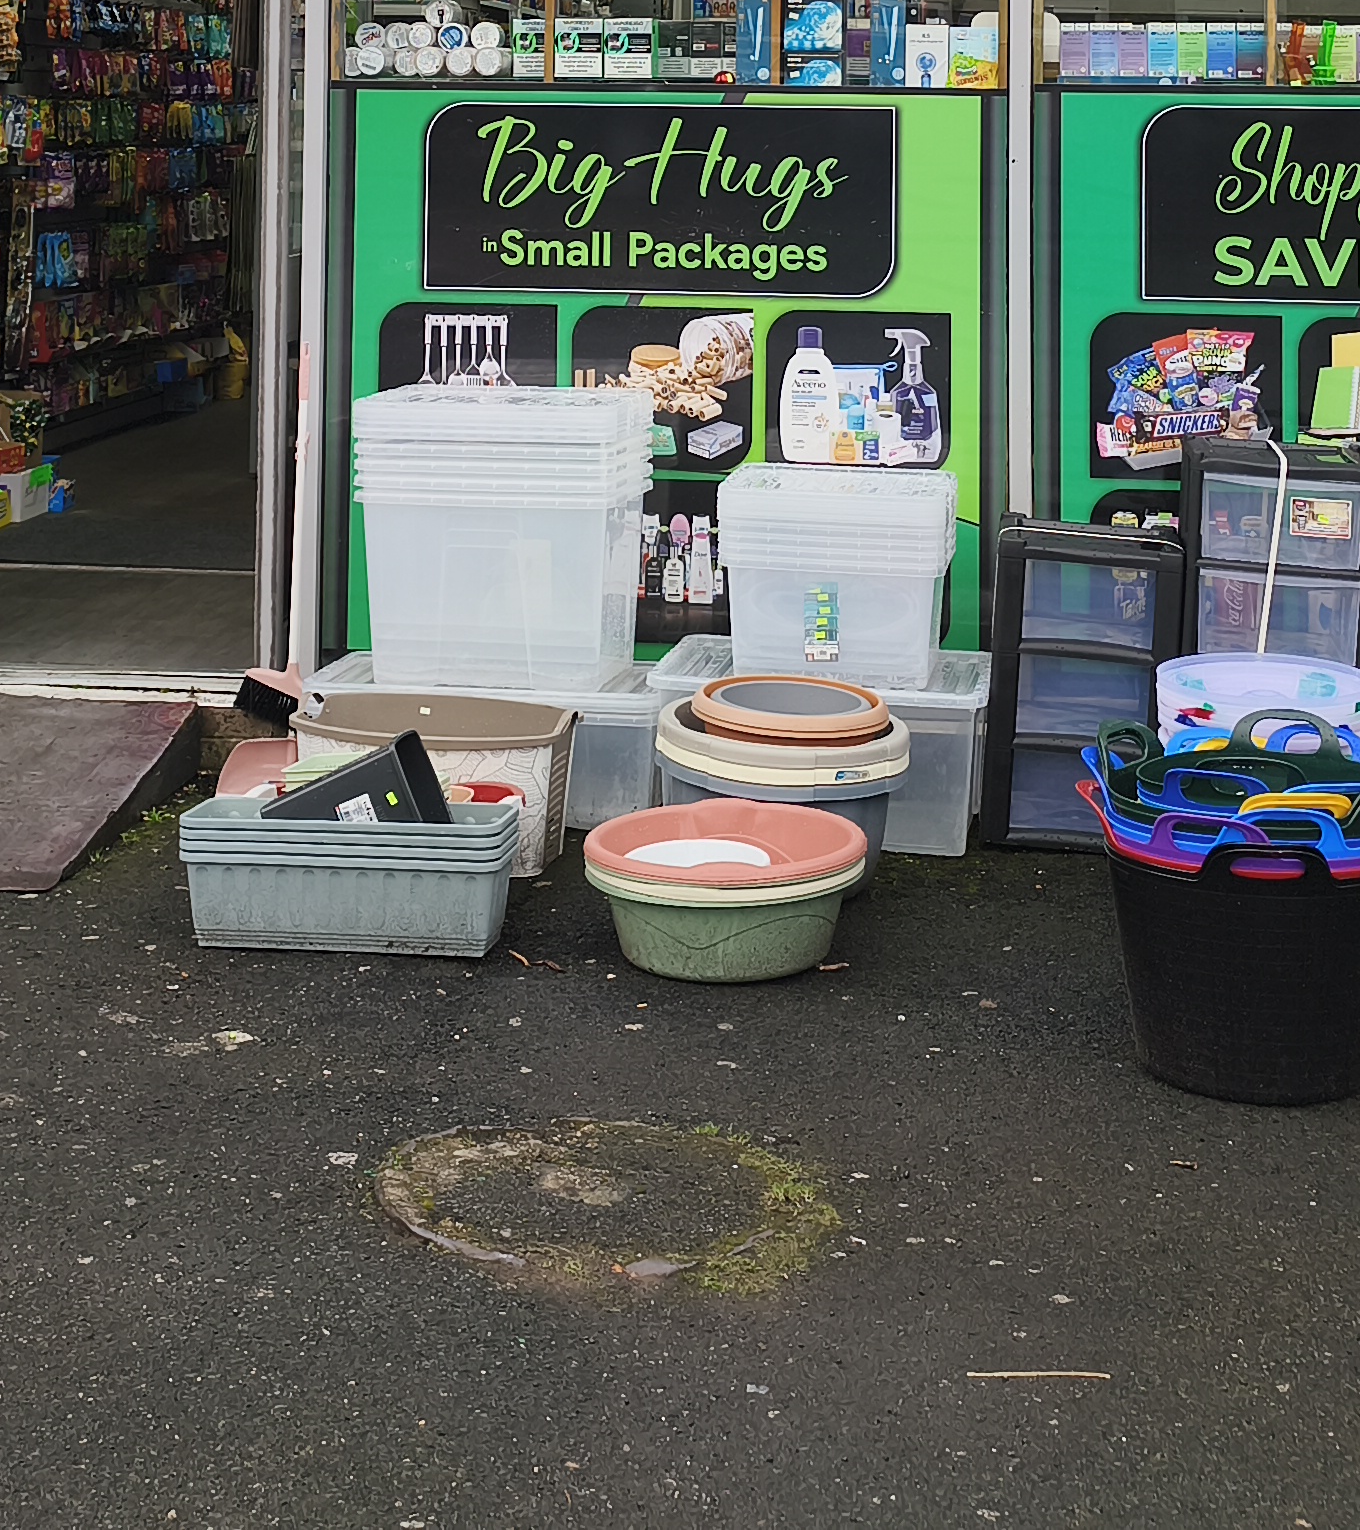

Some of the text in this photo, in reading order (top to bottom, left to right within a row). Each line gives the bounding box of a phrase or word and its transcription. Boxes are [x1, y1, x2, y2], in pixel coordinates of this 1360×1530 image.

[476, 115, 849, 231] Big Hugs
[483, 229, 828, 280] in Small Packages
[1157, 413, 1221, 436] SNICKERS
